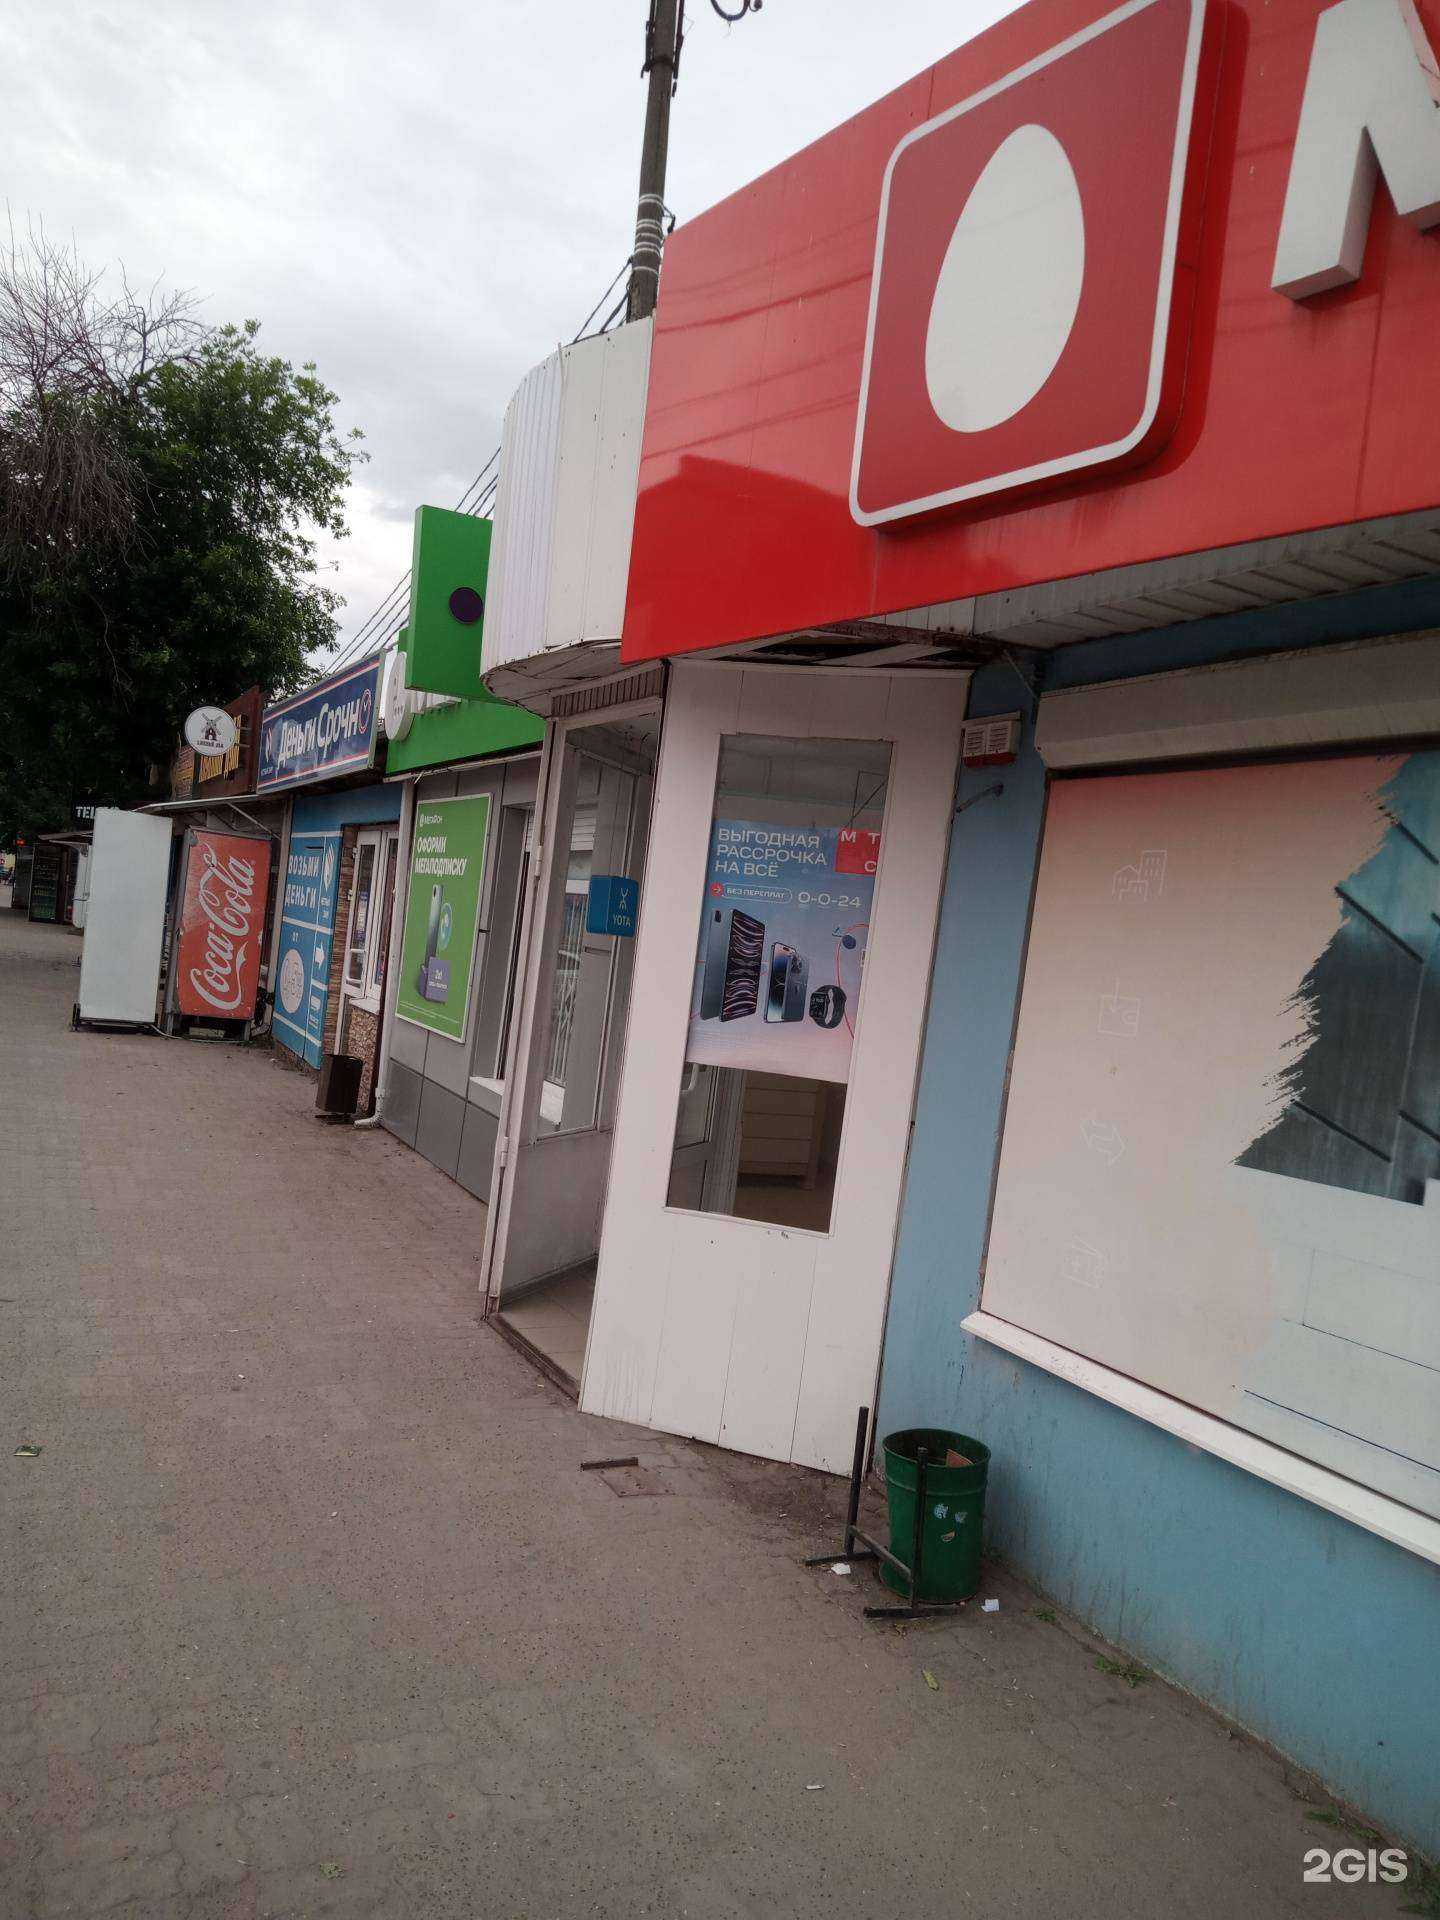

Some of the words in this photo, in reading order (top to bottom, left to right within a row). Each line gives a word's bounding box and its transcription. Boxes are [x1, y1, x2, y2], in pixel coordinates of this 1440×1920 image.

[277, 716, 318, 769] Деньги
[417, 836, 447, 854] ОФОРМИ
[718, 828, 820, 849] ВЫГОДНАЯ
[287, 854, 320, 877] ВОЗЬМИ
[716, 844, 827, 866] РАССРОЧКА
[415, 856, 467, 878] МЕГАПОДПИСКУ
[715, 860, 739, 875] НА
[743, 861, 779, 877] ВСЁ
[284, 884, 317, 909] ДЕНЬГИ
[726, 887, 743, 896] БЕЗ
[743, 889, 785, 899] ПЕРЕПЛАТ
[190, 841, 255, 1010] Coca-Cola
[613, 914, 631, 928] YOTA
